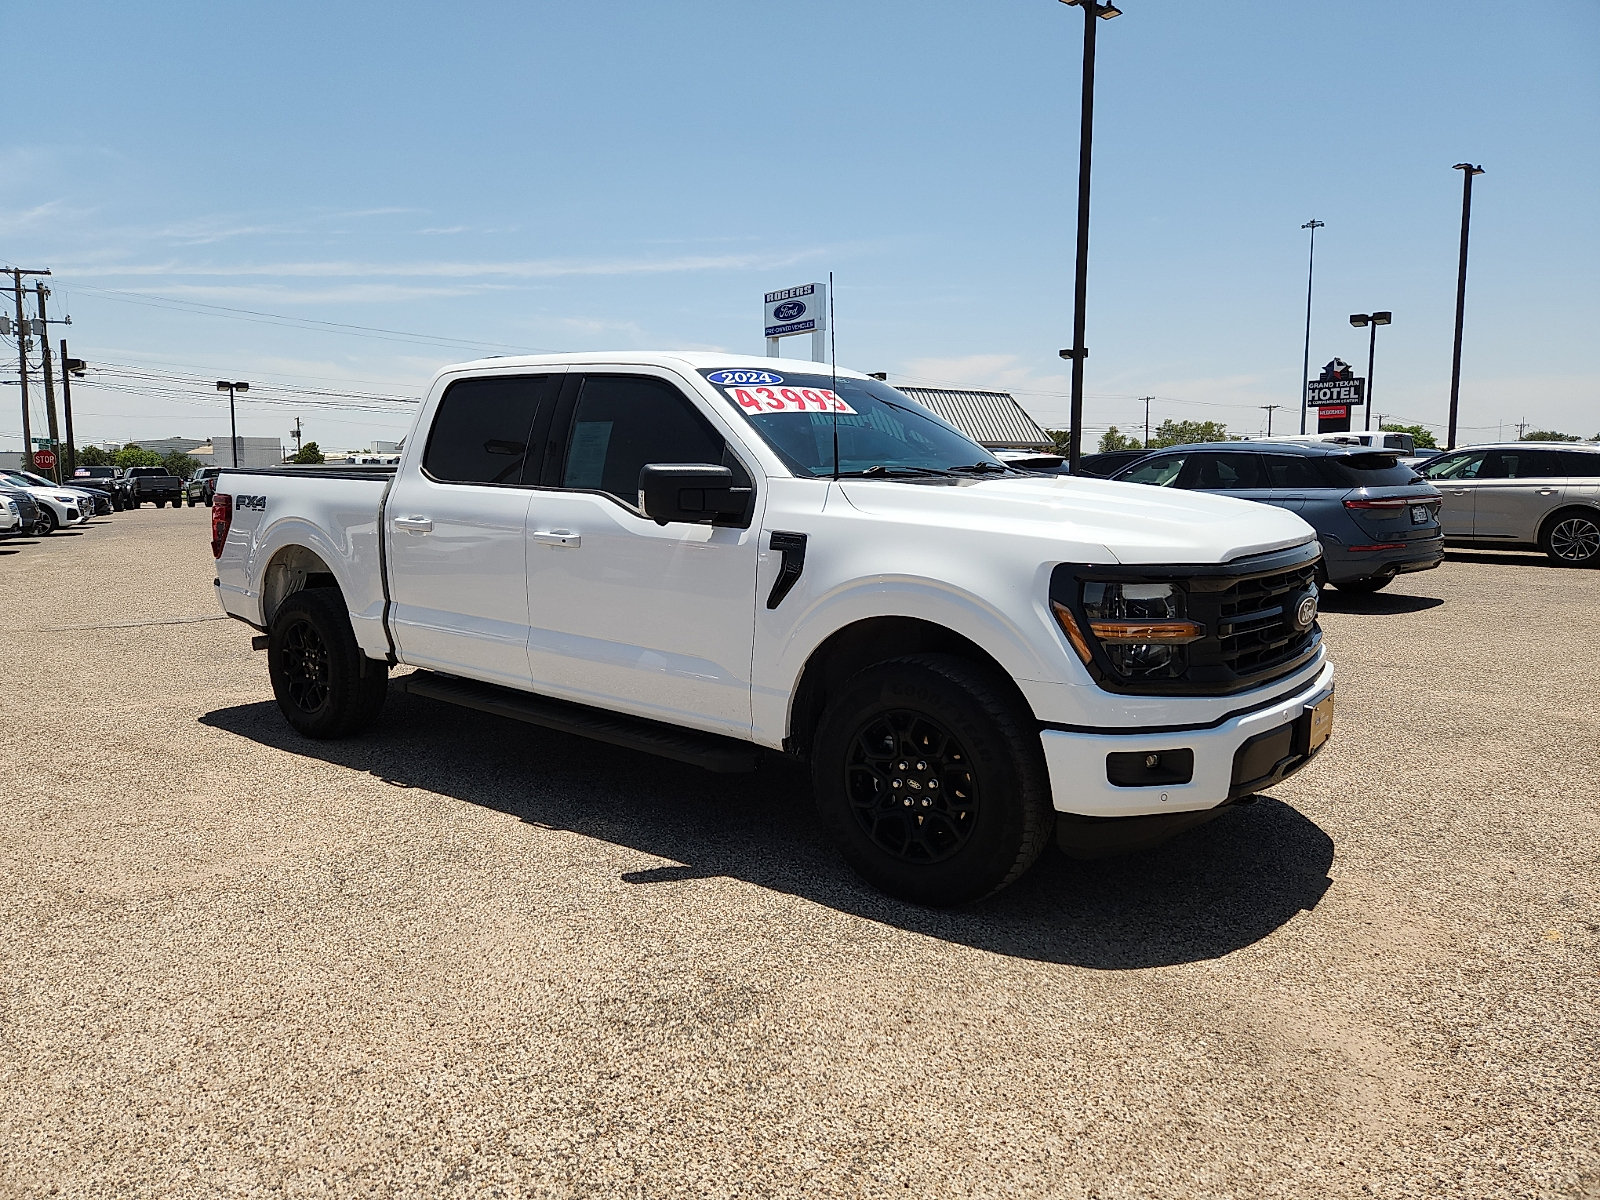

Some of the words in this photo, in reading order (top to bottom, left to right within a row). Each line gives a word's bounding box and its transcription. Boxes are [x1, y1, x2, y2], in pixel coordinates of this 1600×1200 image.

[766, 285, 812, 302] ROGERS
[779, 303, 799, 318] Ford
[721, 372, 773, 384] 2024
[734, 387, 848, 412] 43995
[1308, 387, 1359, 400] HOTEL
[35, 455, 55, 464] STOP
[235, 494, 267, 511] FX4
